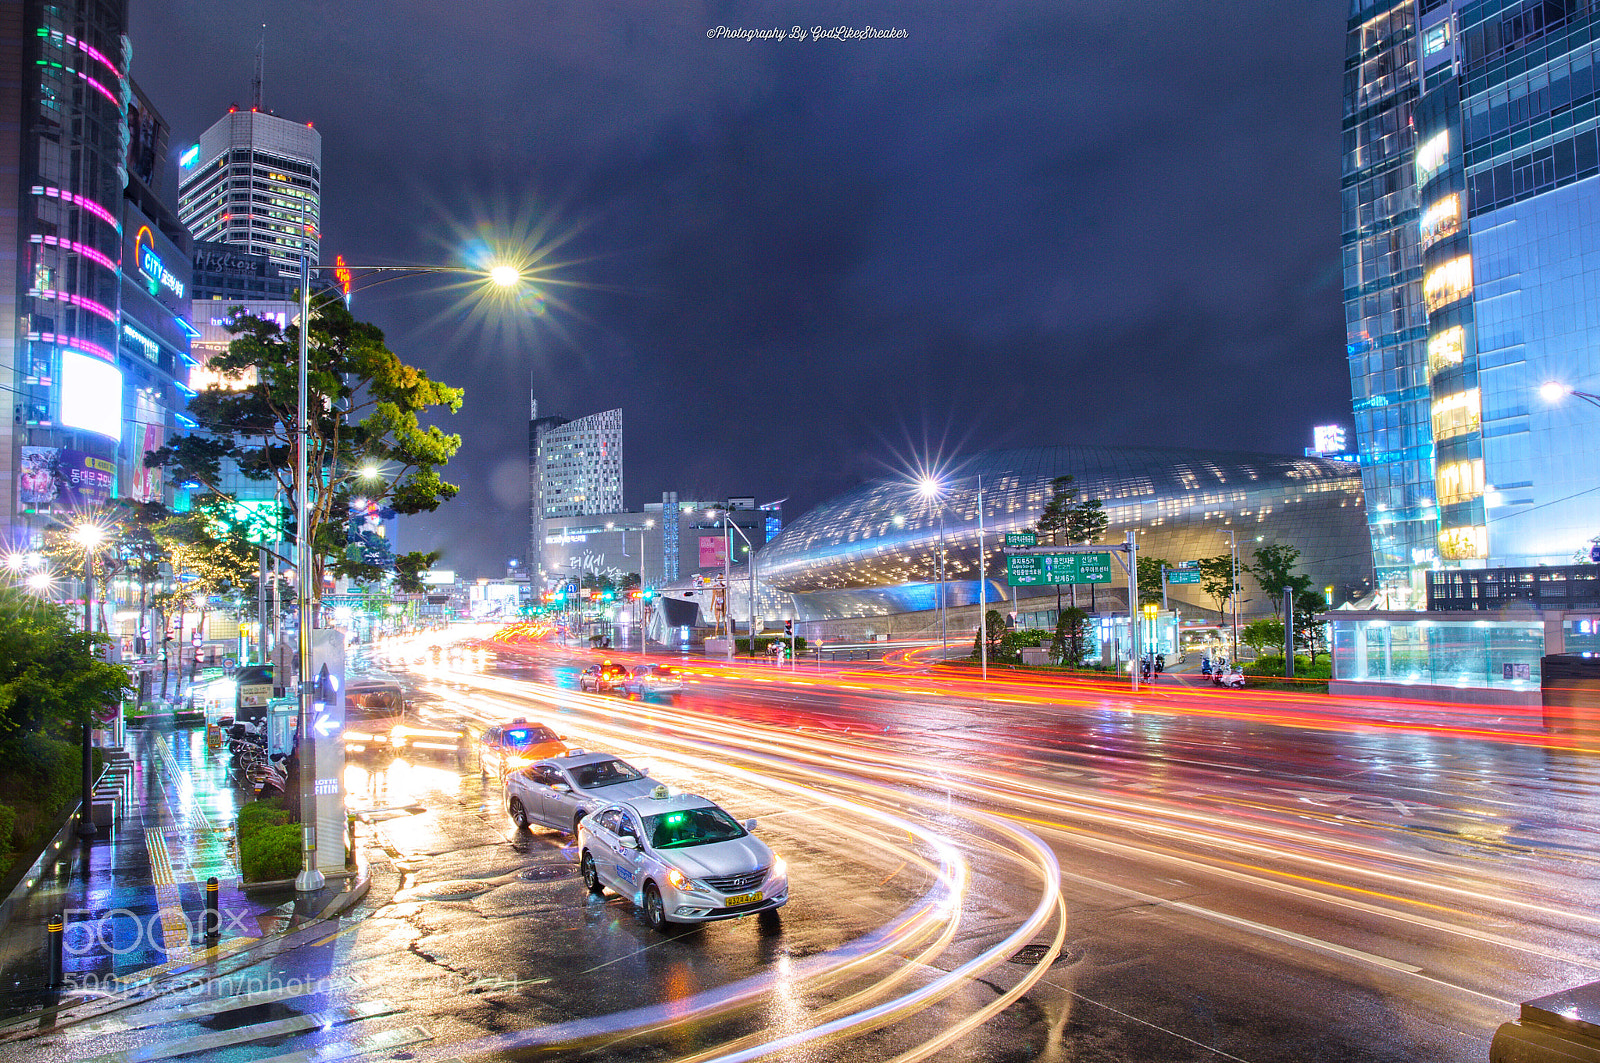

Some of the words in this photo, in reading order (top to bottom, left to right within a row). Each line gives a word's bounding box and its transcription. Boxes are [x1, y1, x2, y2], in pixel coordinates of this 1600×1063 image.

[145, 253, 163, 279] CITY
[196, 249, 257, 272] Migliore
[71, 468, 95, 486] 동대문
[315, 785, 338, 795] FITIN
